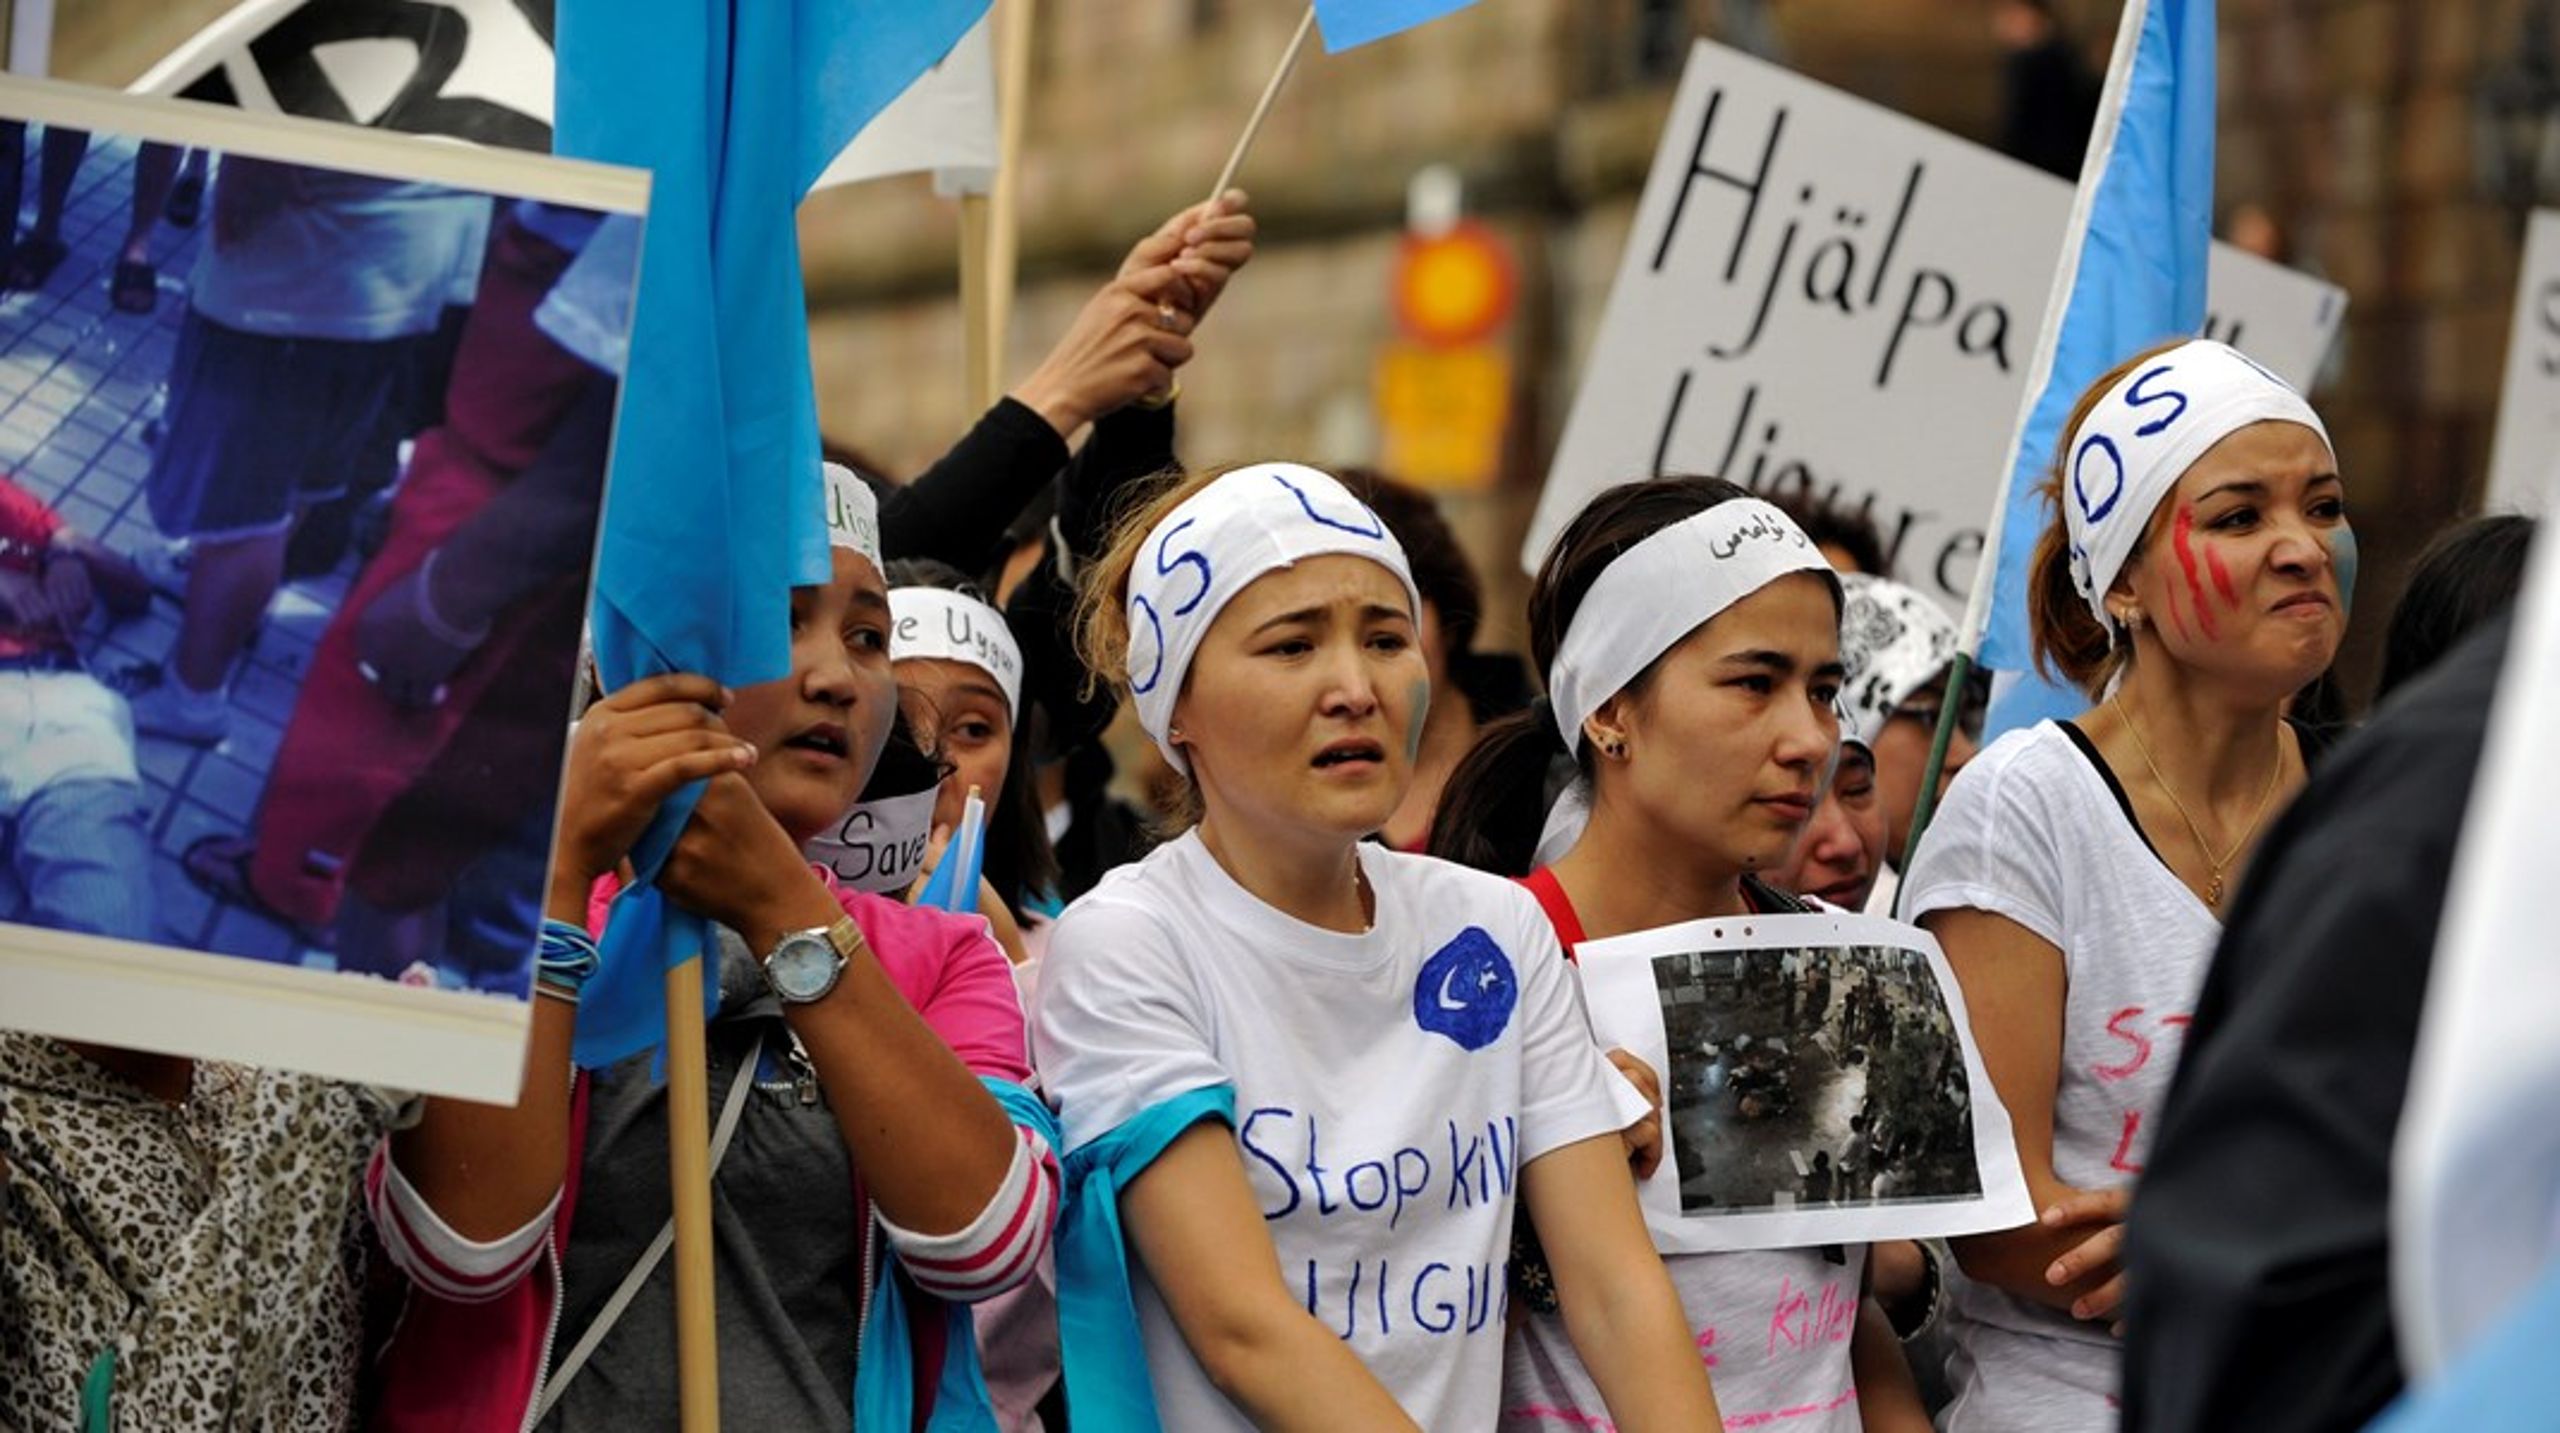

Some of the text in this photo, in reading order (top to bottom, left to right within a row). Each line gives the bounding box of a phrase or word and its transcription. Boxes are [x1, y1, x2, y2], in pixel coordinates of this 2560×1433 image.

[1650, 88, 2011, 388] Hjälpa
[831, 810, 928, 882] Save
[1241, 1106, 1431, 1231] Stop
[1308, 1259, 1509, 1341] UIGU
